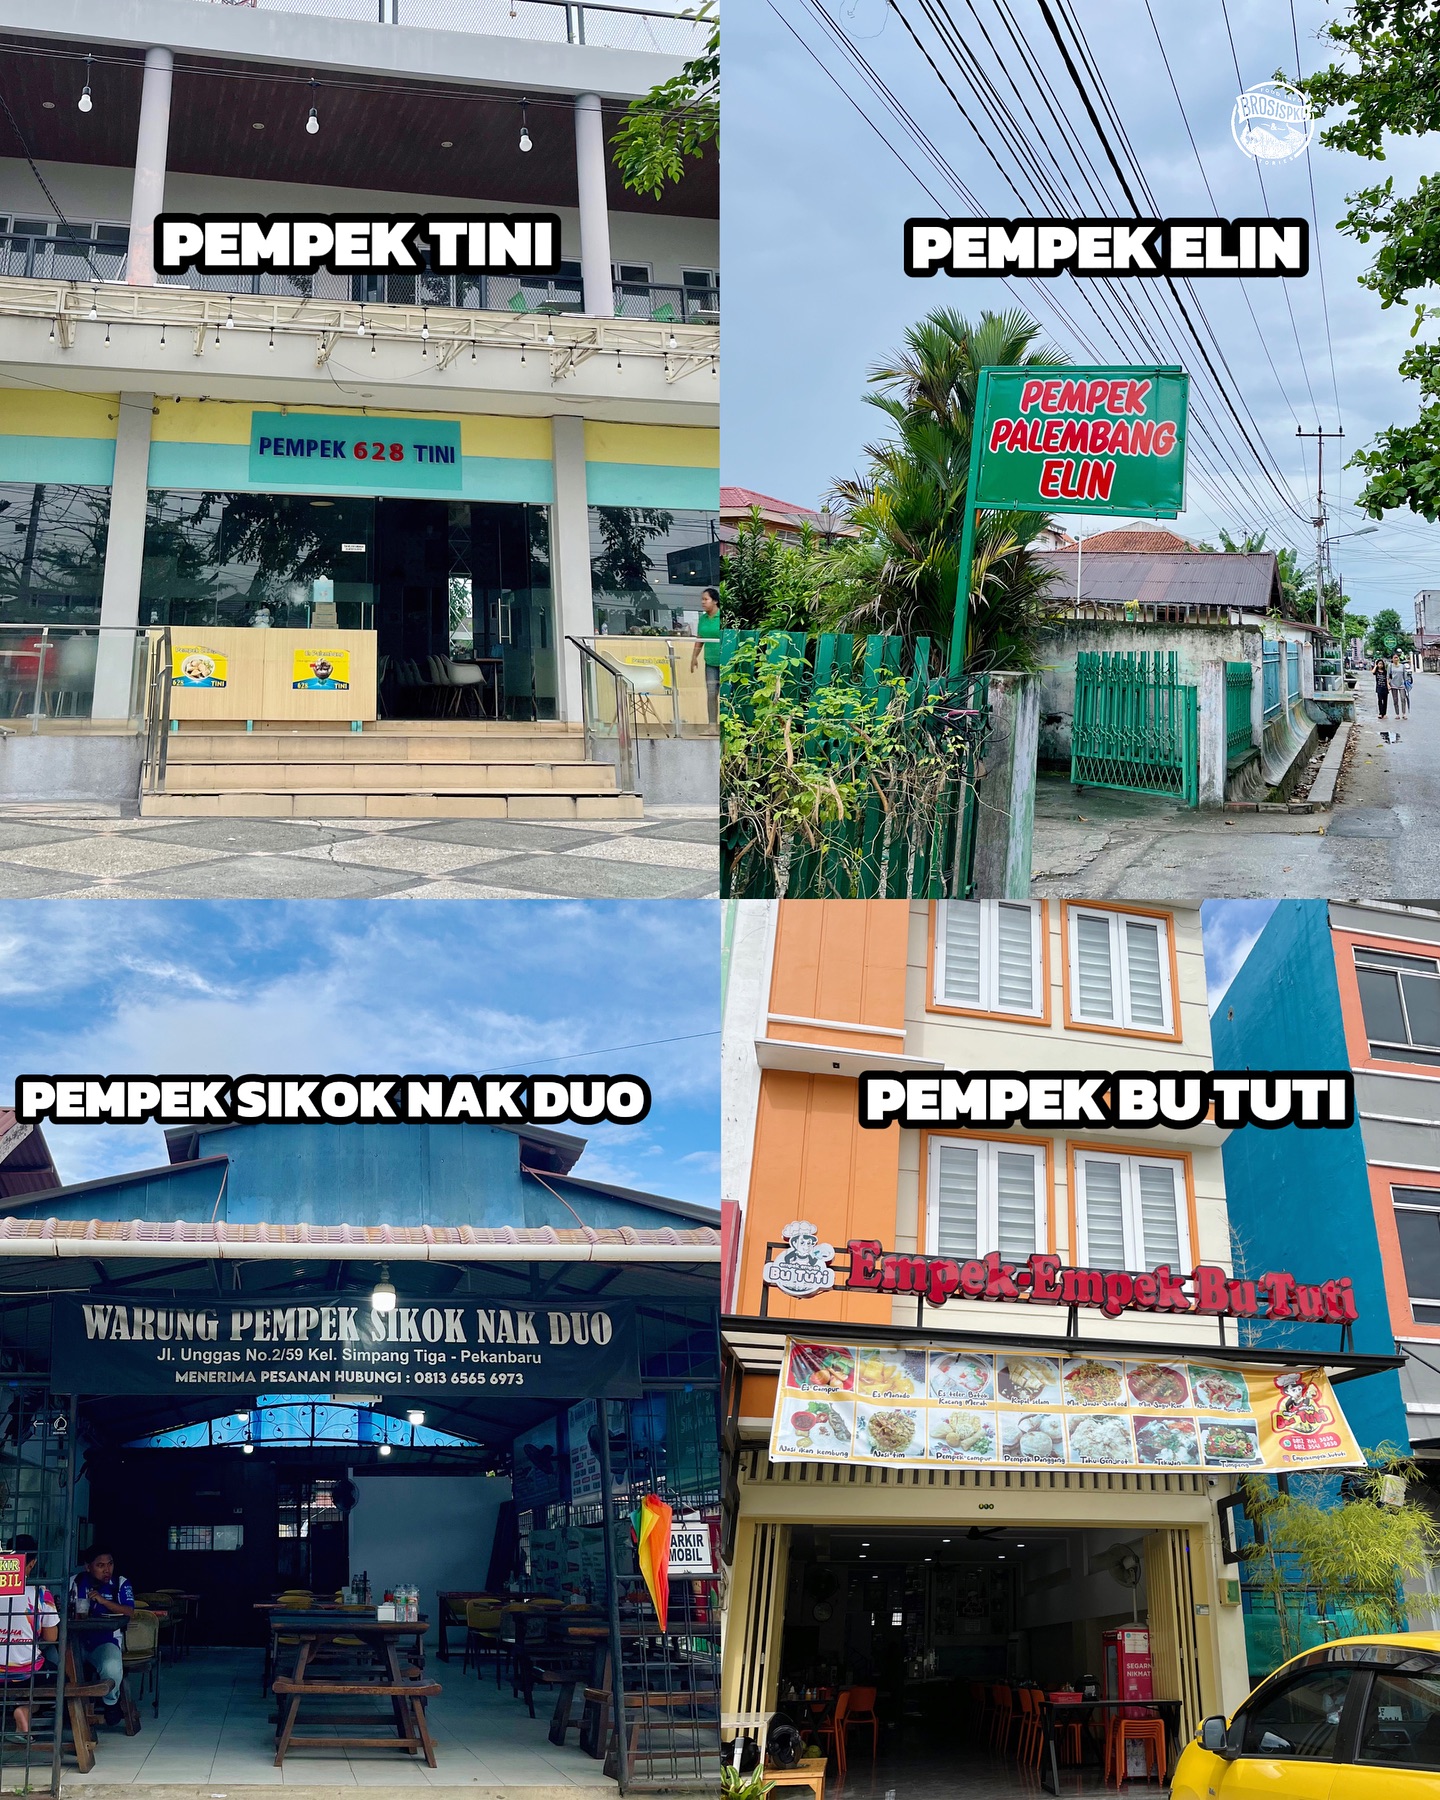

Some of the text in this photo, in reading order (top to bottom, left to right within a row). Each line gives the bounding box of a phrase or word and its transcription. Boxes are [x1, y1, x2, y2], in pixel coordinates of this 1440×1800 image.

[1019, 378, 1152, 416] PEMPEK
[259, 437, 455, 464] PEMPEK 628 TINI
[989, 418, 1178, 457] PALEMBANG
[1039, 459, 1117, 500] ELIN
[769, 1266, 829, 1284] Bu Tuti
[847, 1240, 1360, 1322] Empek-Empek Bu Tuti
[82, 1304, 613, 1345] WARUNG PEMPEK SIKOK NAK DUO
[157, 1348, 175, 1361] Jl.
[181, 1348, 240, 1364] Unggas
[246, 1348, 303, 1362] No.2/59
[308, 1348, 337, 1361] Kel.
[342, 1348, 409, 1365] Simpang
[413, 1349, 446, 1365] Tiga
[461, 1350, 542, 1364] Pekanbaru
[175, 1371, 256, 1383] MENERIMA
[260, 1371, 331, 1383] PESANAN
[335, 1371, 401, 1383] HUBUNGI
[414, 1372, 447, 1384] 0813
[451, 1373, 486, 1384] 6565
[490, 1373, 524, 1385] 6973
[671, 1534, 704, 1547] ARKIR
[669, 1548, 703, 1561] MOBIL
